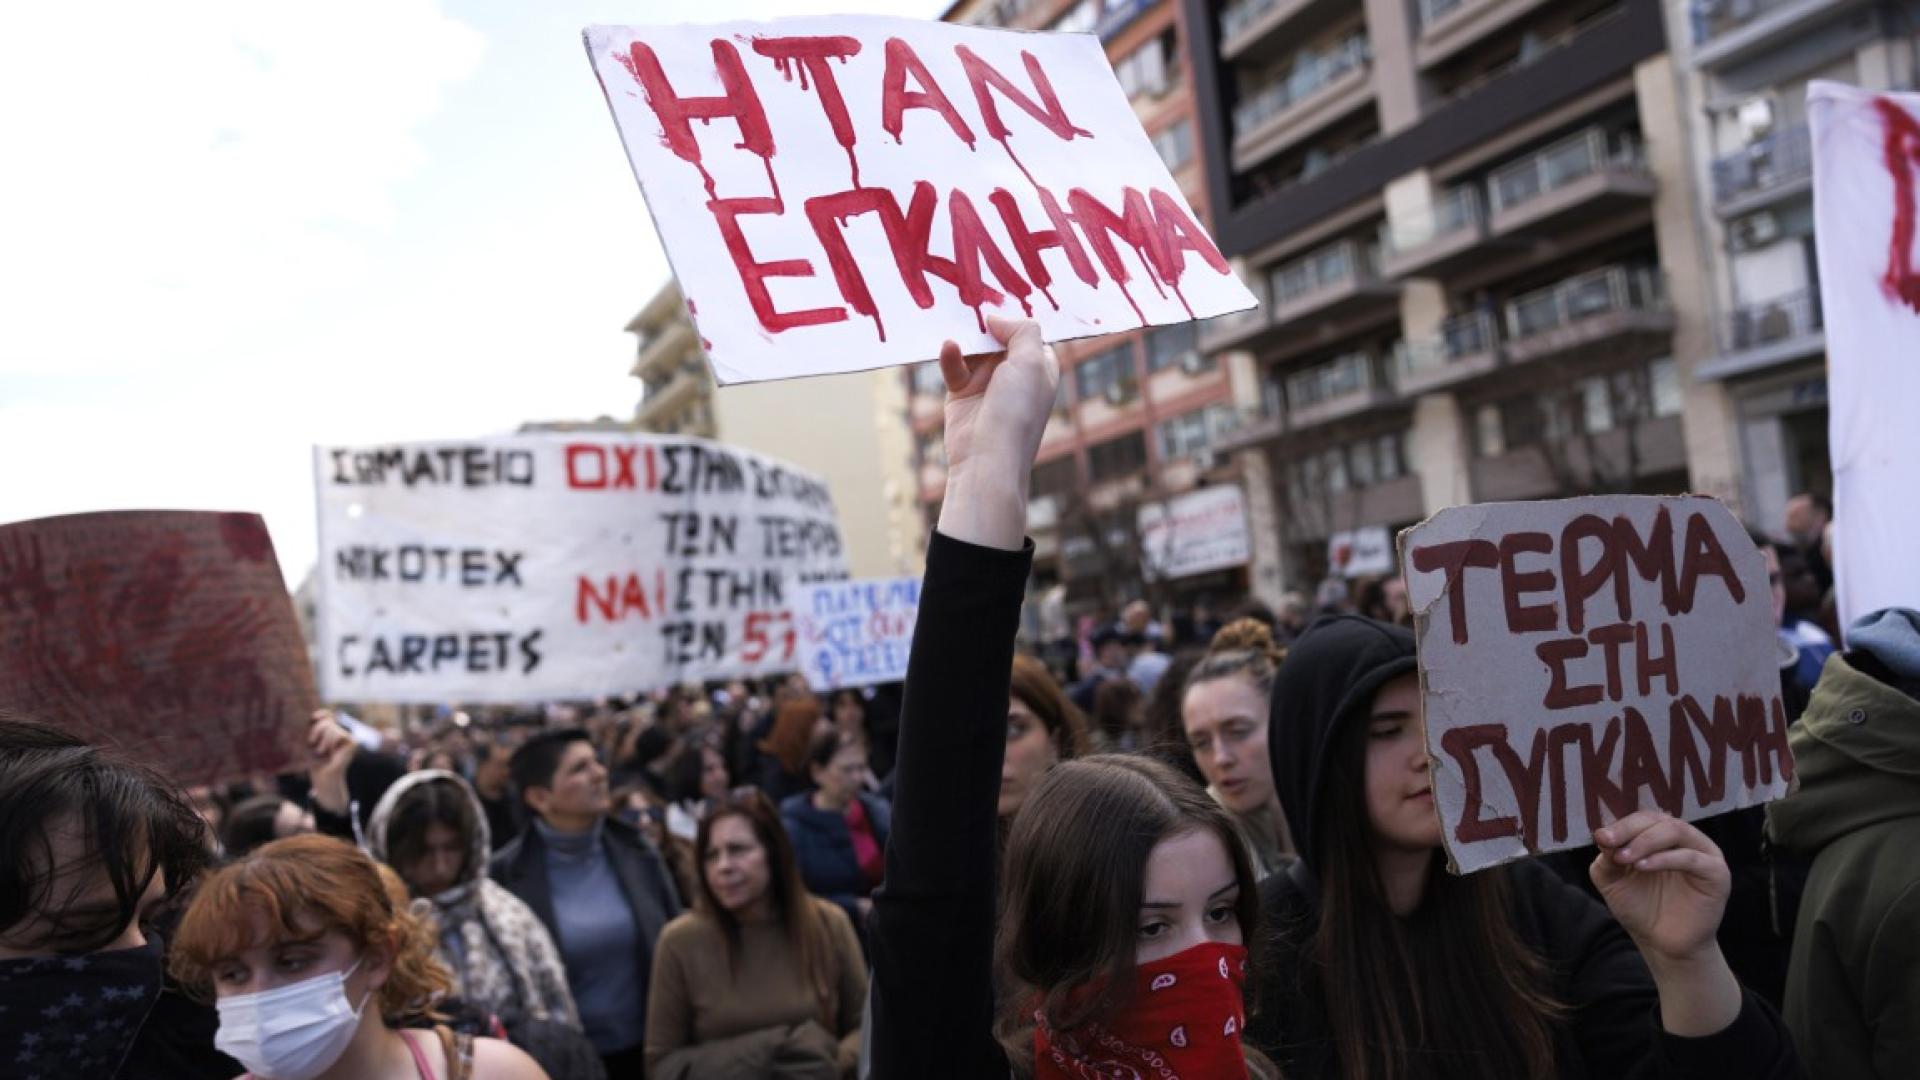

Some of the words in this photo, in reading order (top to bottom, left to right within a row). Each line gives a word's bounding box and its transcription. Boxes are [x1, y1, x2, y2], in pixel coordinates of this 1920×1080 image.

[627, 35, 1093, 163] ΗΤΑΝ
[706, 180, 1231, 334] ΕΓΚΛΗΜΑ
[331, 446, 534, 487] ΣΩΜΑΤΕΙΟ
[564, 443, 656, 490] ΟΧΙ
[661, 445, 745, 495] ΣΤΗΝ
[659, 513, 738, 557] ΤΩΝ
[336, 545, 524, 588] NIKOTEX
[1412, 503, 1746, 645] ΤΕΡΜΑ
[576, 569, 666, 623] ΝΑΙ
[673, 567, 784, 612] ΣΤΗΝ
[339, 627, 545, 678] CARPETS
[660, 620, 728, 665] ΤΩΝ
[740, 611, 798, 662] 57
[1535, 621, 1679, 710] ΣΤΗ
[1441, 693, 1795, 854] ΣΥΓΚΑΛΥΨΗ
